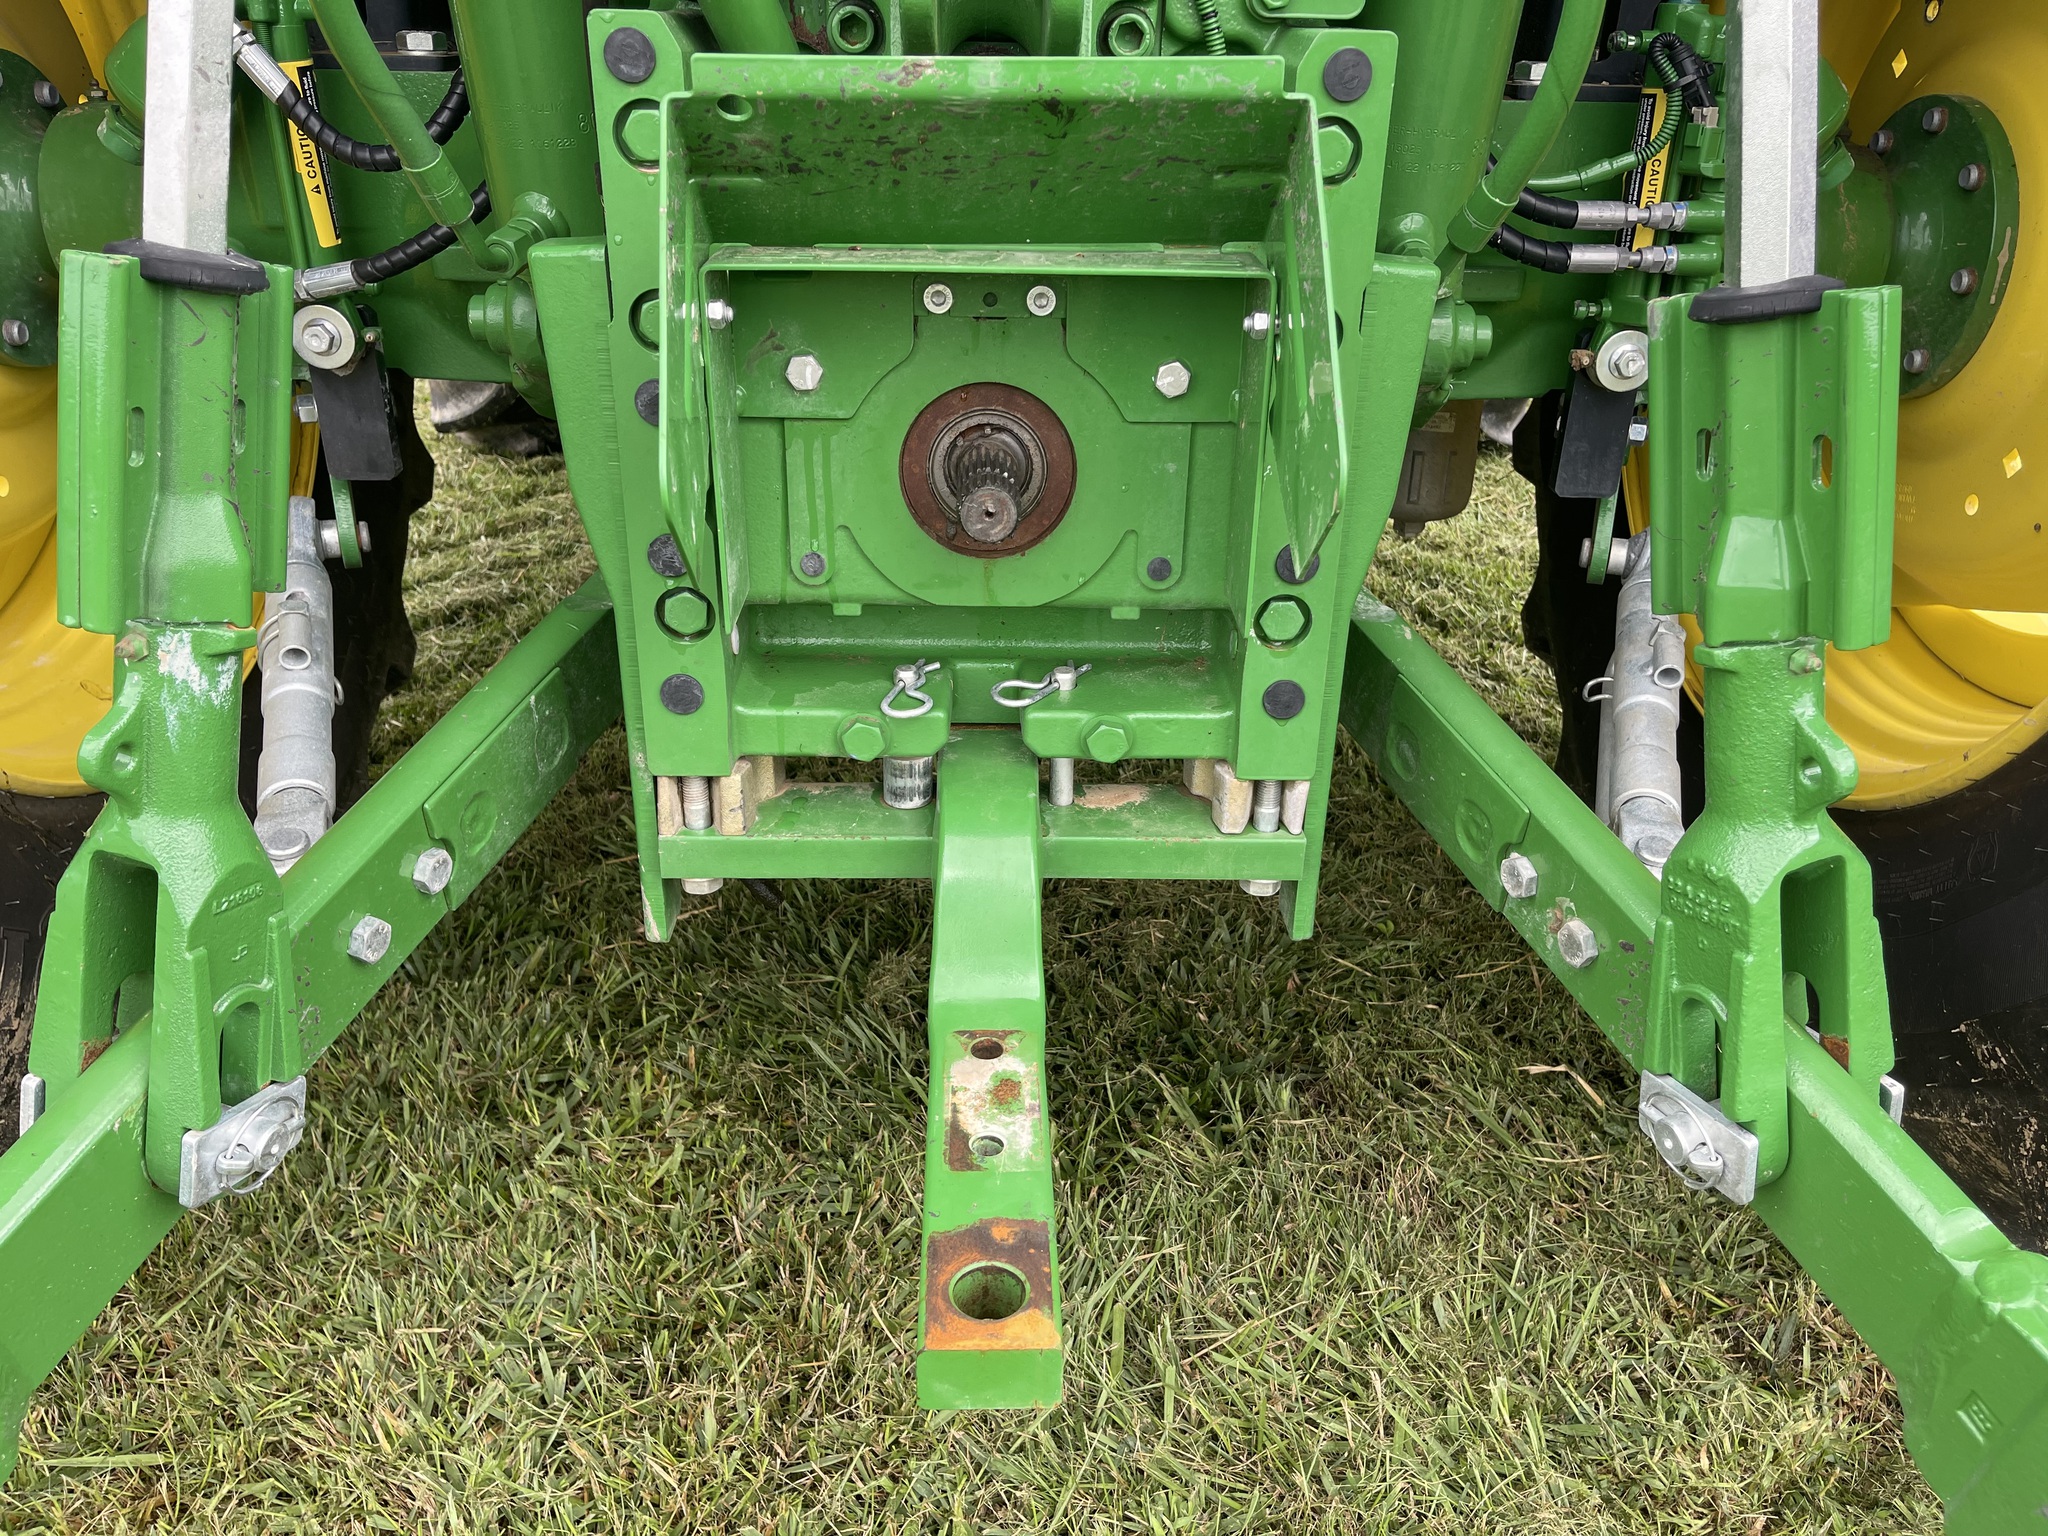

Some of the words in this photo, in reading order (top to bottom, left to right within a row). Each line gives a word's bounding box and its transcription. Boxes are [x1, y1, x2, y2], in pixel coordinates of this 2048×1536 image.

[1645, 105, 1653, 121] avoid
[1642, 120, 1650, 136] injury
[296, 128, 317, 179] CAUTIO
[1629, 168, 1637, 194] nstruction
[1632, 172, 1642, 201] movement
[1645, 158, 1662, 207] CAUTIO
